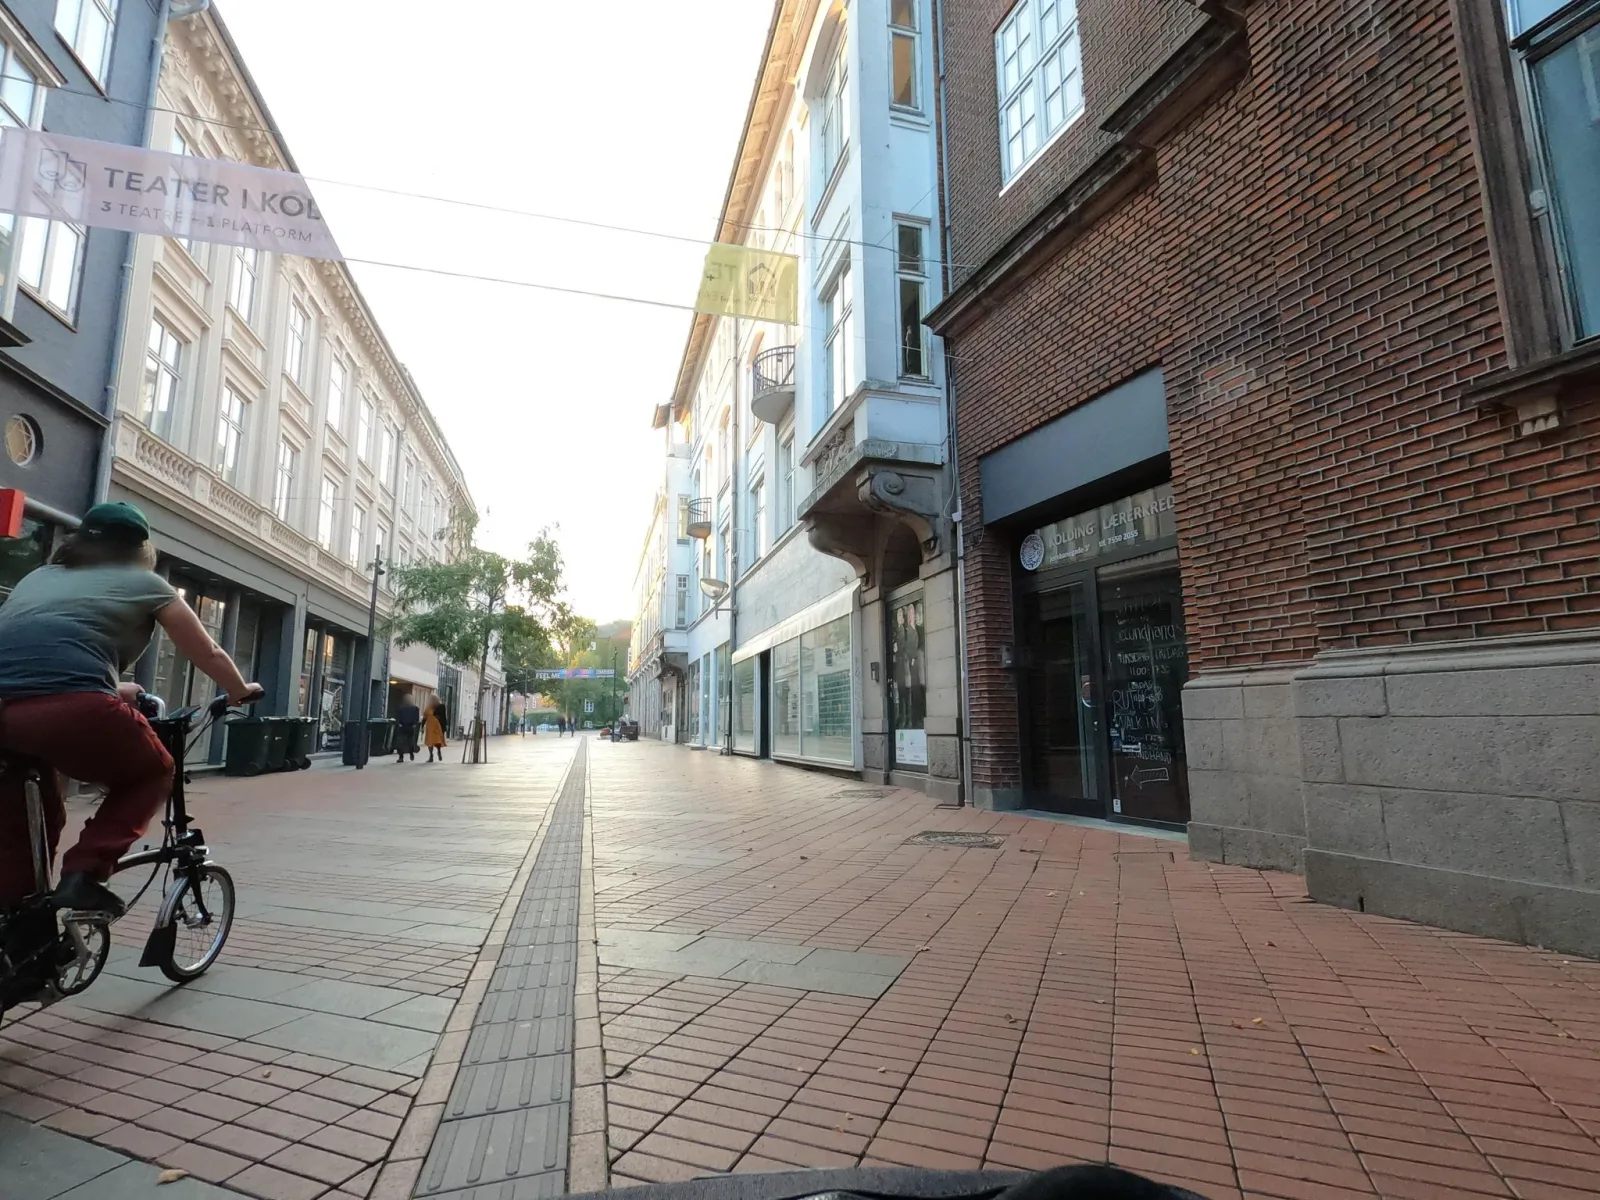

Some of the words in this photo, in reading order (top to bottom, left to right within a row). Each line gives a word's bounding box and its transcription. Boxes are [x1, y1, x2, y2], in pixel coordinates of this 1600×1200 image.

[103, 166, 231, 207] TEATER
[242, 188, 249, 209] I
[100, 200, 112, 213] 3
[119, 203, 183, 225] TEATRE
[221, 217, 313, 244] PLATFORM
[1048, 522, 1095, 548] KOLDING
[1107, 534, 1122, 545] 7550
[1123, 529, 1139, 540] 2055
